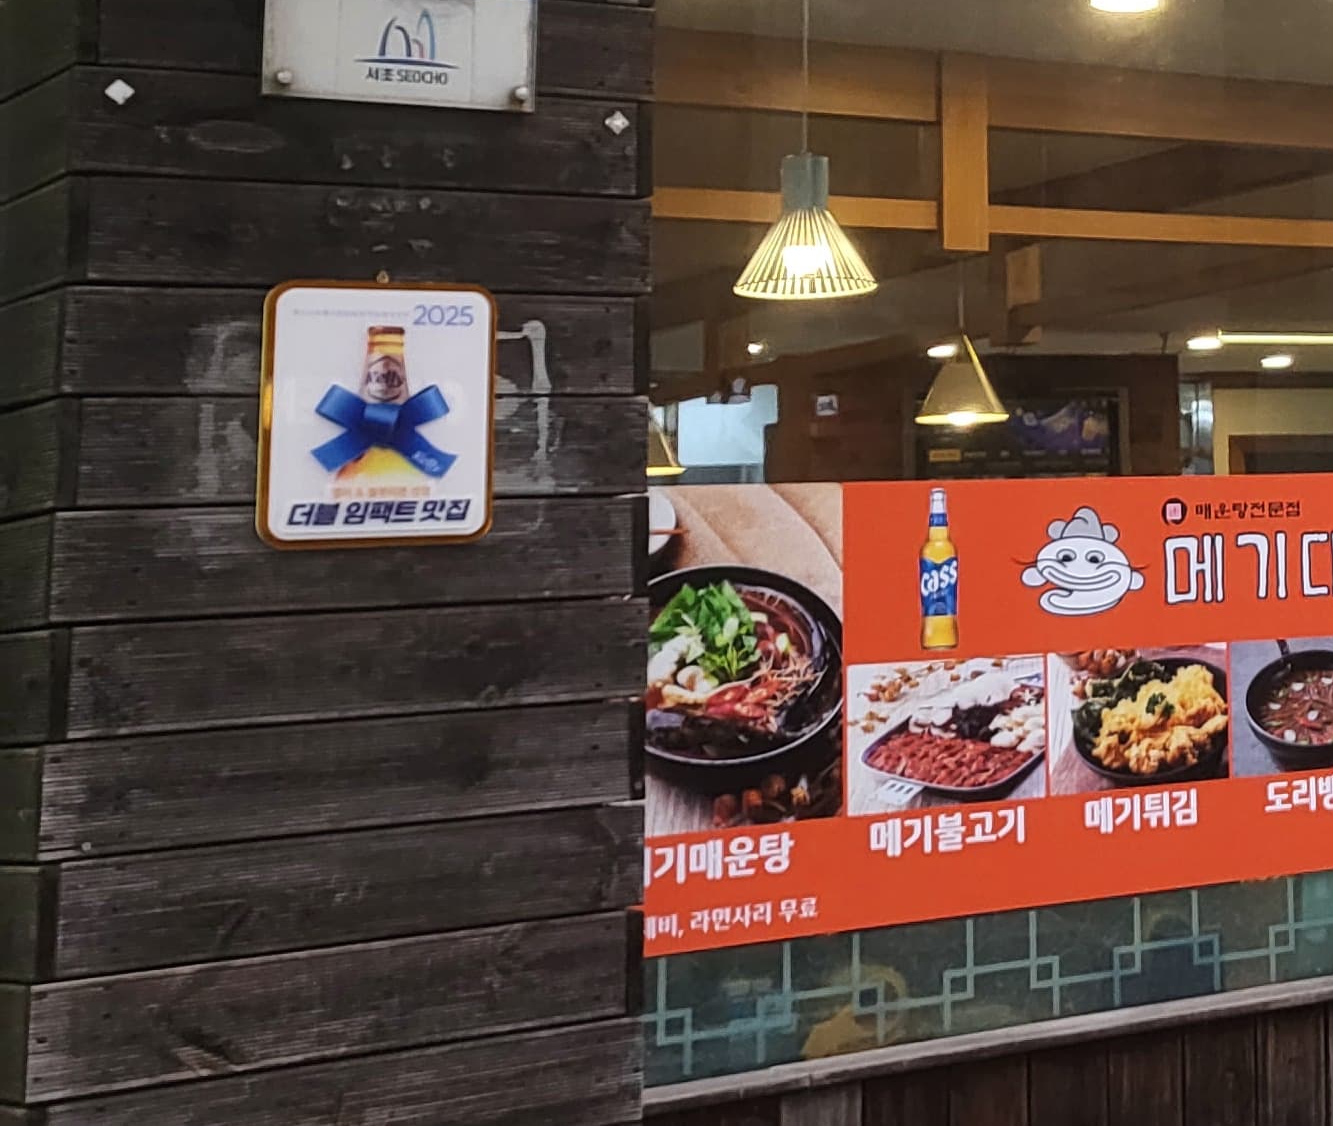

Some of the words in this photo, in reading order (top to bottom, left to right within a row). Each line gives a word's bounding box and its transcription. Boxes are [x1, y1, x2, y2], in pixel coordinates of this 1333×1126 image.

[396, 69, 449, 86] SEOCHO
[413, 305, 474, 326] 2025
[286, 502, 341, 526] 더블
[342, 500, 418, 524] 임팩트
[419, 498, 471, 521] 맛집
[1195, 501, 1302, 520] 매운탕전문점
[1083, 788, 1199, 834] 메기튀김
[869, 806, 1027, 858] 메기불고기
[643, 832, 795, 888] 기매운탕
[690, 902, 773, 934] 라면사리
[779, 897, 818, 923] 무료
